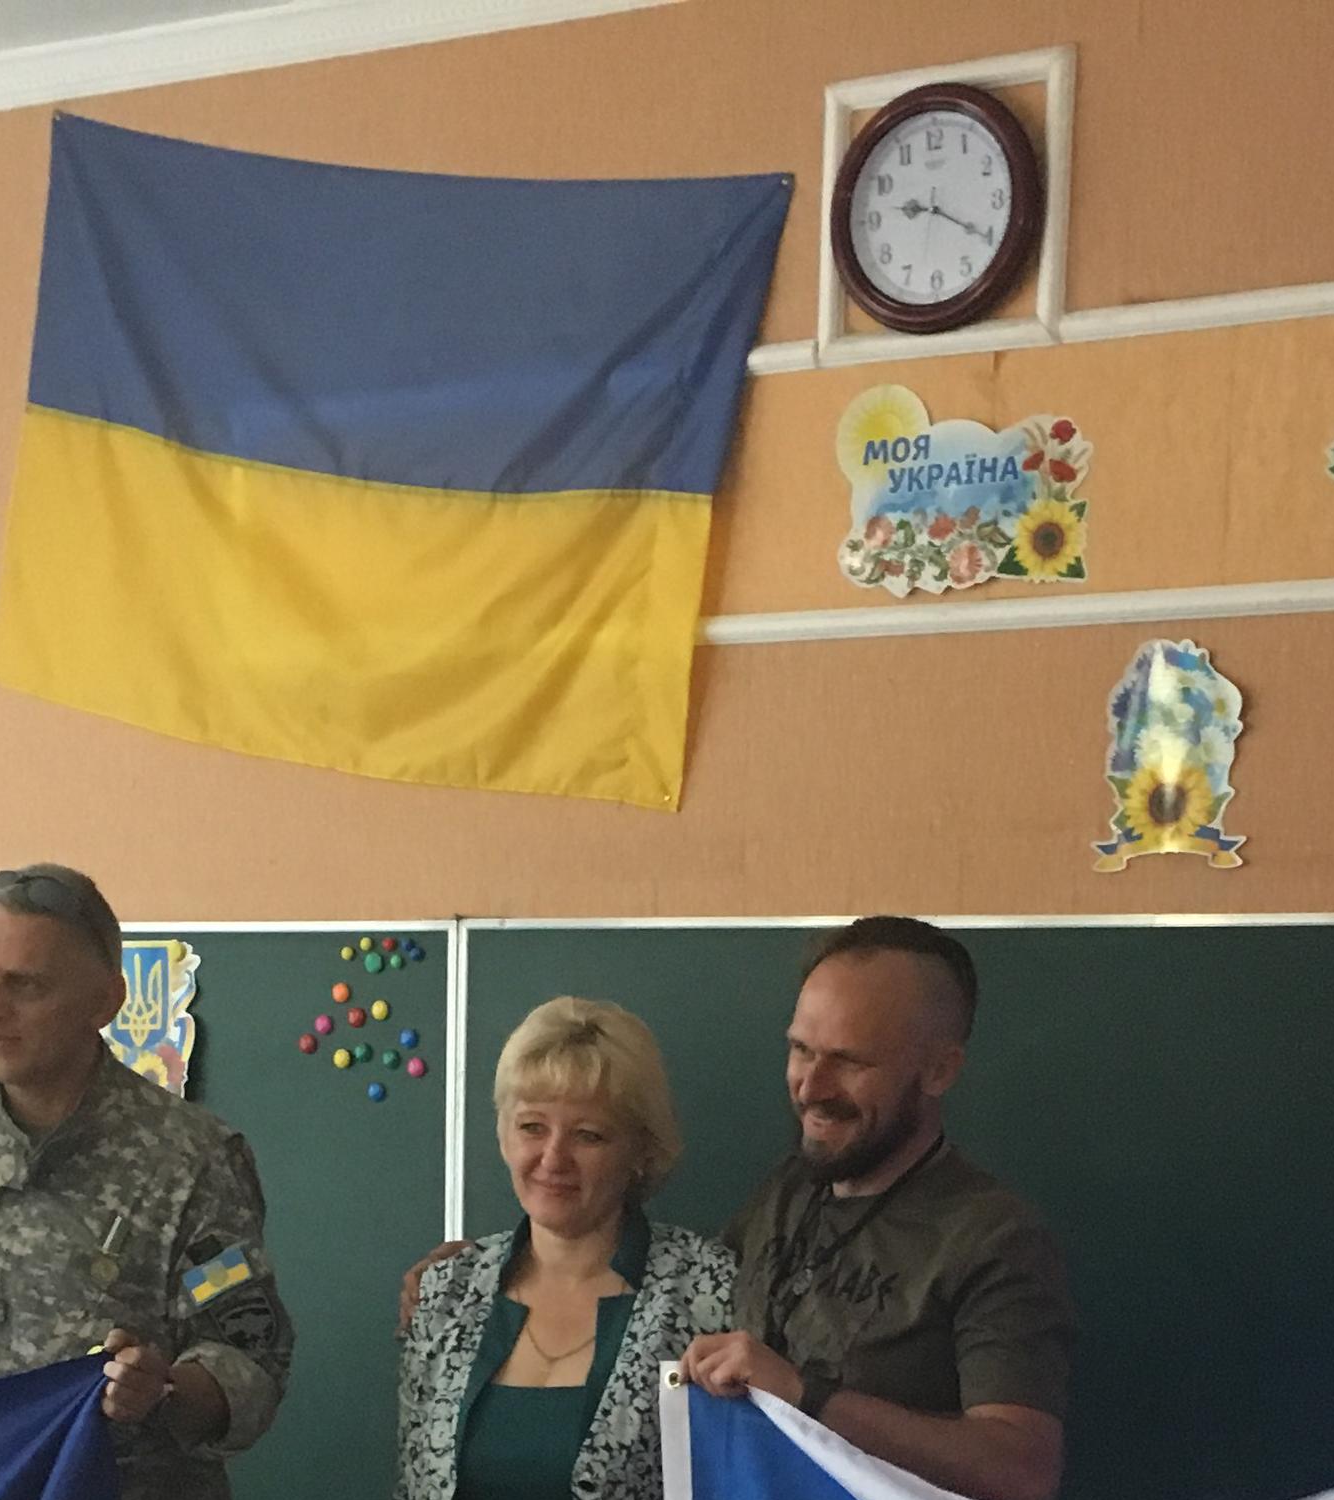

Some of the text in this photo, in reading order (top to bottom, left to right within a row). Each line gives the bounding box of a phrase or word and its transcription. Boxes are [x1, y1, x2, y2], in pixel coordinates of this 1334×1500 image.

[926, 128, 944, 151] 12
[961, 133, 968, 154] 1
[980, 154, 993, 176] 2
[877, 173, 894, 196] 10
[991, 188, 1005, 210] 3
[868, 210, 882, 231] 9
[879, 242, 892, 265] 8
[901, 263, 913, 286] 7
[960, 255, 972, 278] 5
[931, 269, 945, 291] 6
[863, 434, 931, 466] МОЯ
[888, 453, 1019, 494] УКРАЇНА
